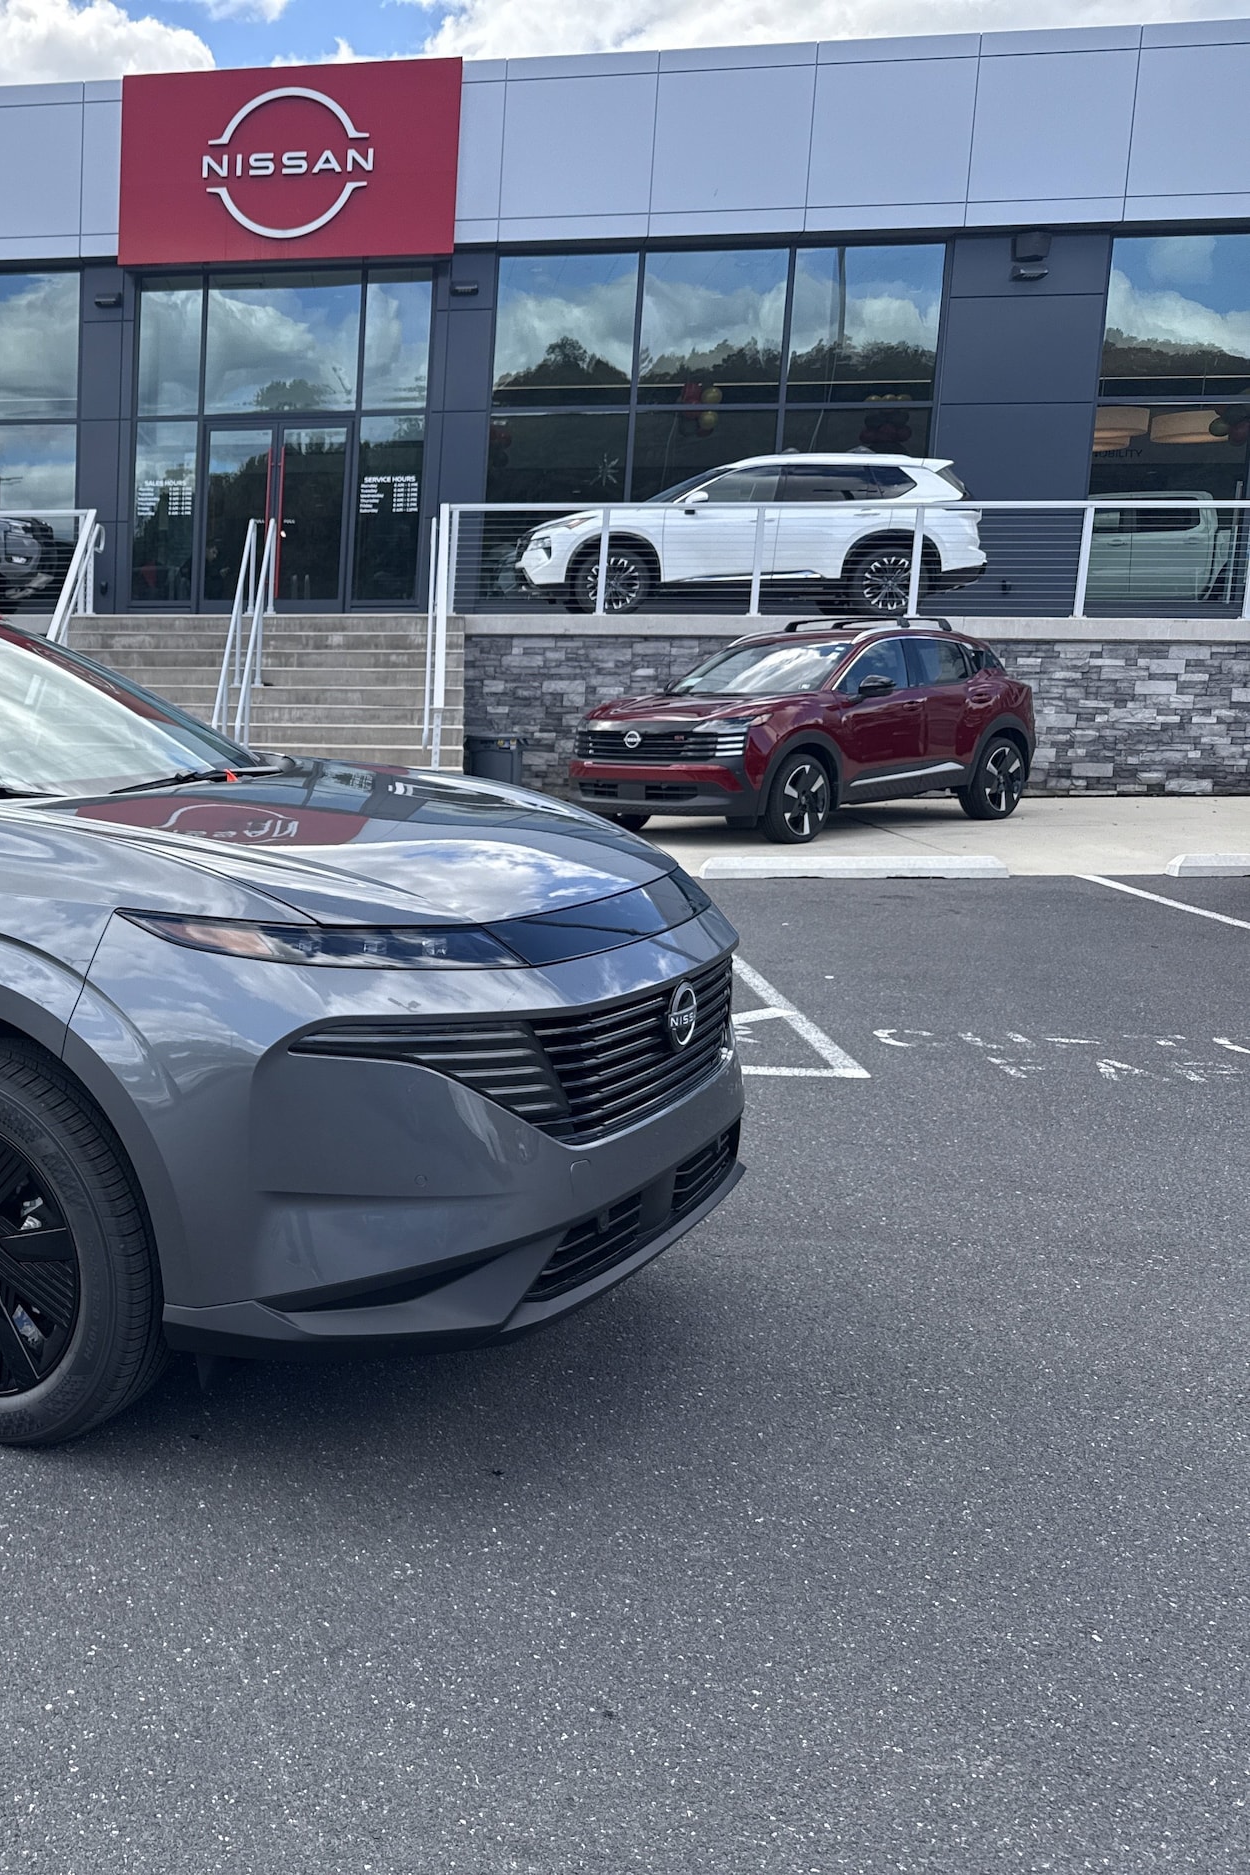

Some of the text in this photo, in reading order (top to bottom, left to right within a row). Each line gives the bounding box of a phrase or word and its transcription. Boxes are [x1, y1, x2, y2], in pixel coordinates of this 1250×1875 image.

[202, 148, 375, 179] NISSAN
[1094, 449, 1143, 458] OBILITY
[144, 479, 188, 487] SALES HOURS
[364, 475, 417, 484] SERVICE HOURS
